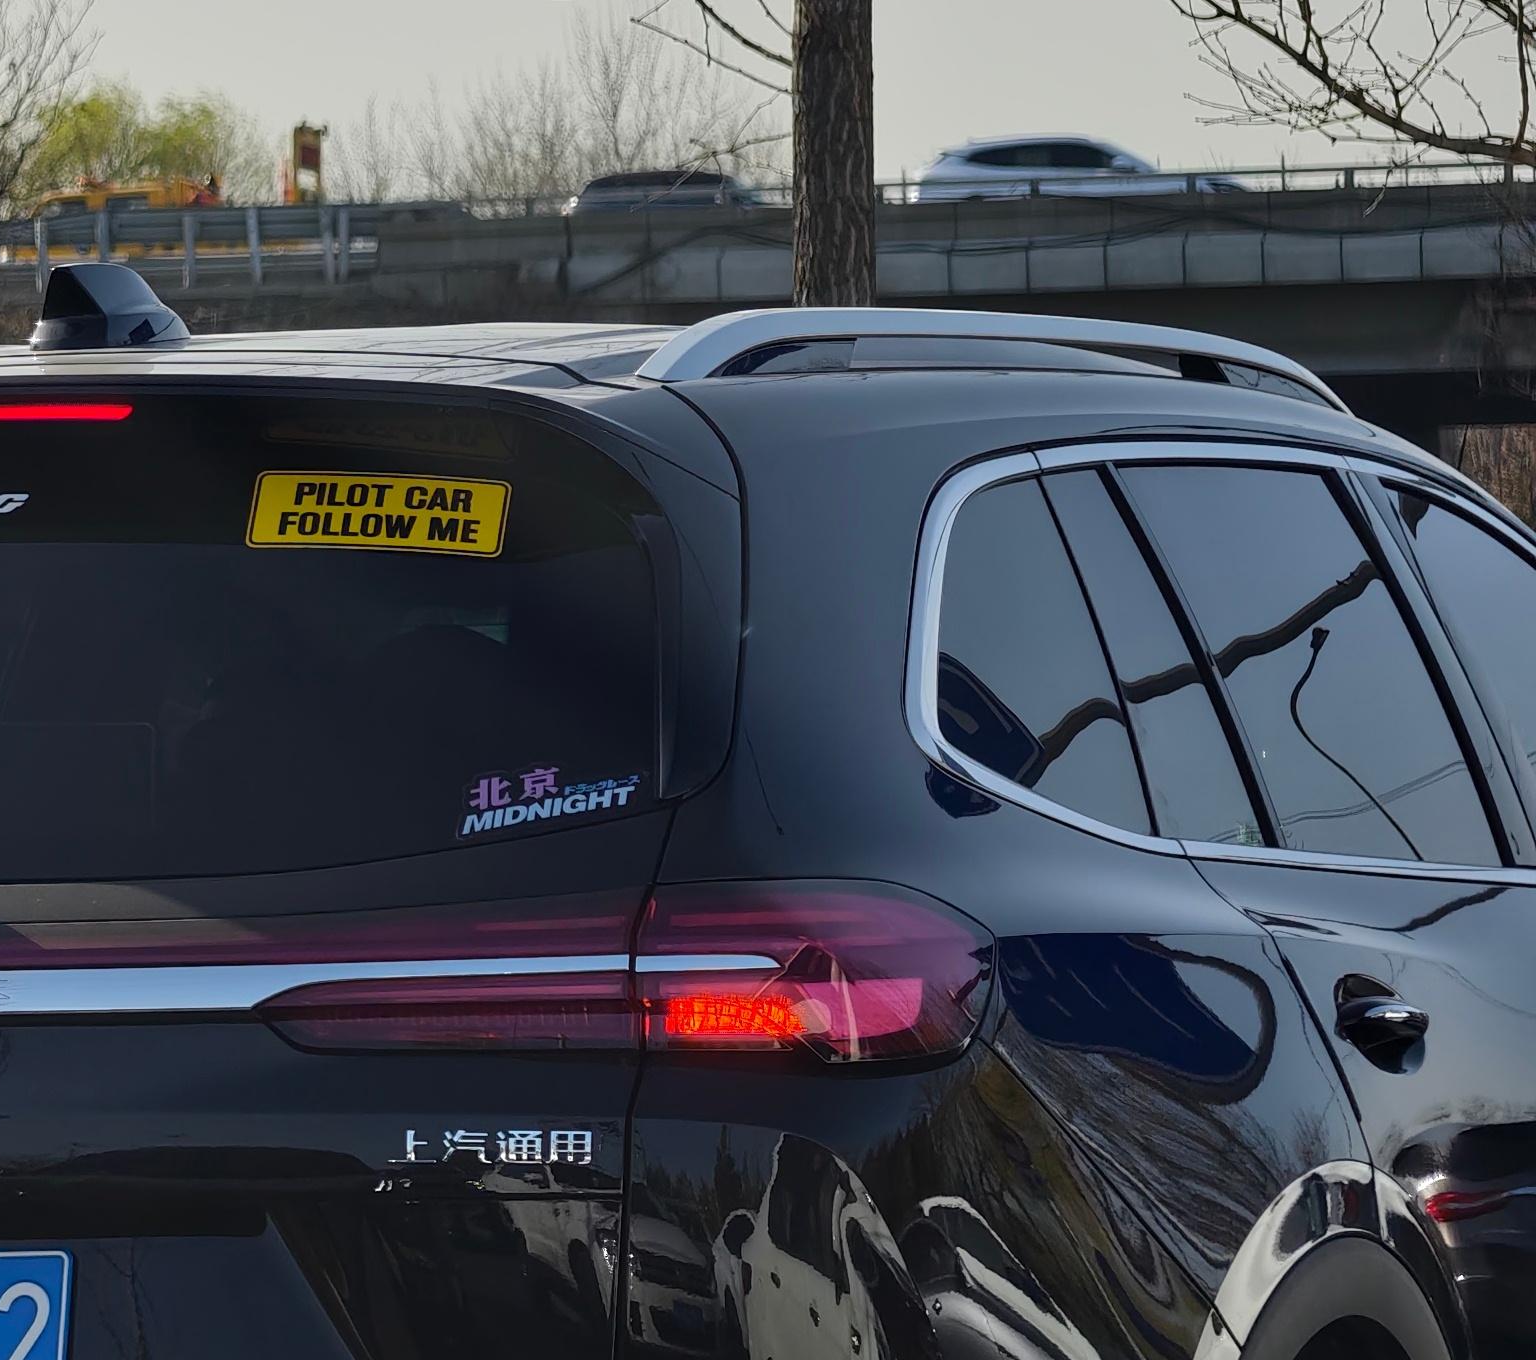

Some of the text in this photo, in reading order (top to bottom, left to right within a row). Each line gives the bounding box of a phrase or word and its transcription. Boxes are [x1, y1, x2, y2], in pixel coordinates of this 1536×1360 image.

[294, 482, 474, 513] PILOT CAR
[277, 512, 481, 544] FOLLOW ME
[469, 767, 560, 810] 北京
[462, 786, 635, 835] MIDNIGHT
[386, 1129, 593, 1165] 上汽通用
